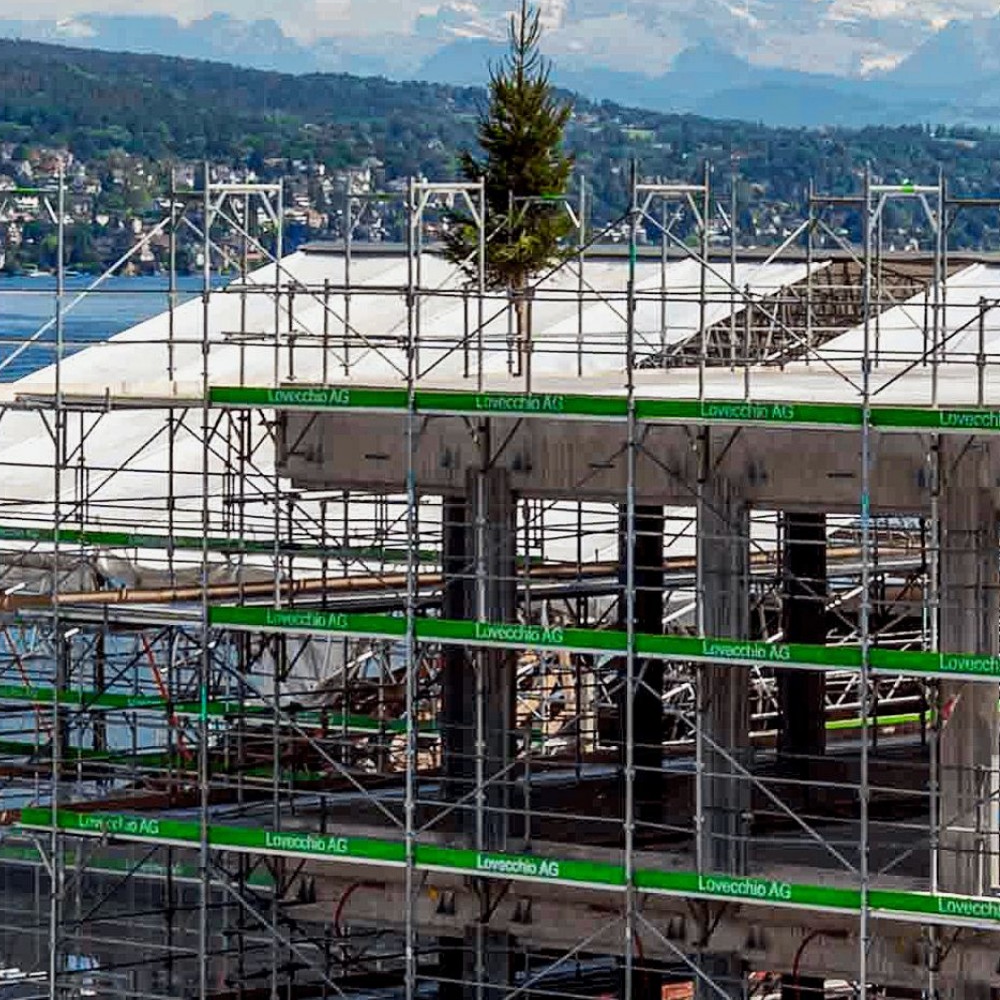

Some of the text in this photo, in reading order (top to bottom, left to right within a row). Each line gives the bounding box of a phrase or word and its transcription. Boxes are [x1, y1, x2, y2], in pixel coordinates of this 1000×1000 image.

[269, 389, 350, 403] Lovecchio AG
[542, 395, 564, 410] AG
[701, 401, 794, 419] Lovecchio AG
[328, 613, 348, 628] AG
[474, 624, 564, 642] Lovecchio AG
[702, 641, 790, 660] Lovecchio AG
[139, 818, 160, 834] AG
[265, 832, 348, 853] Lovecchio AG
[476, 853, 560, 877] Lovecchio AG
[698, 875, 792, 899] Lovecchio AG
